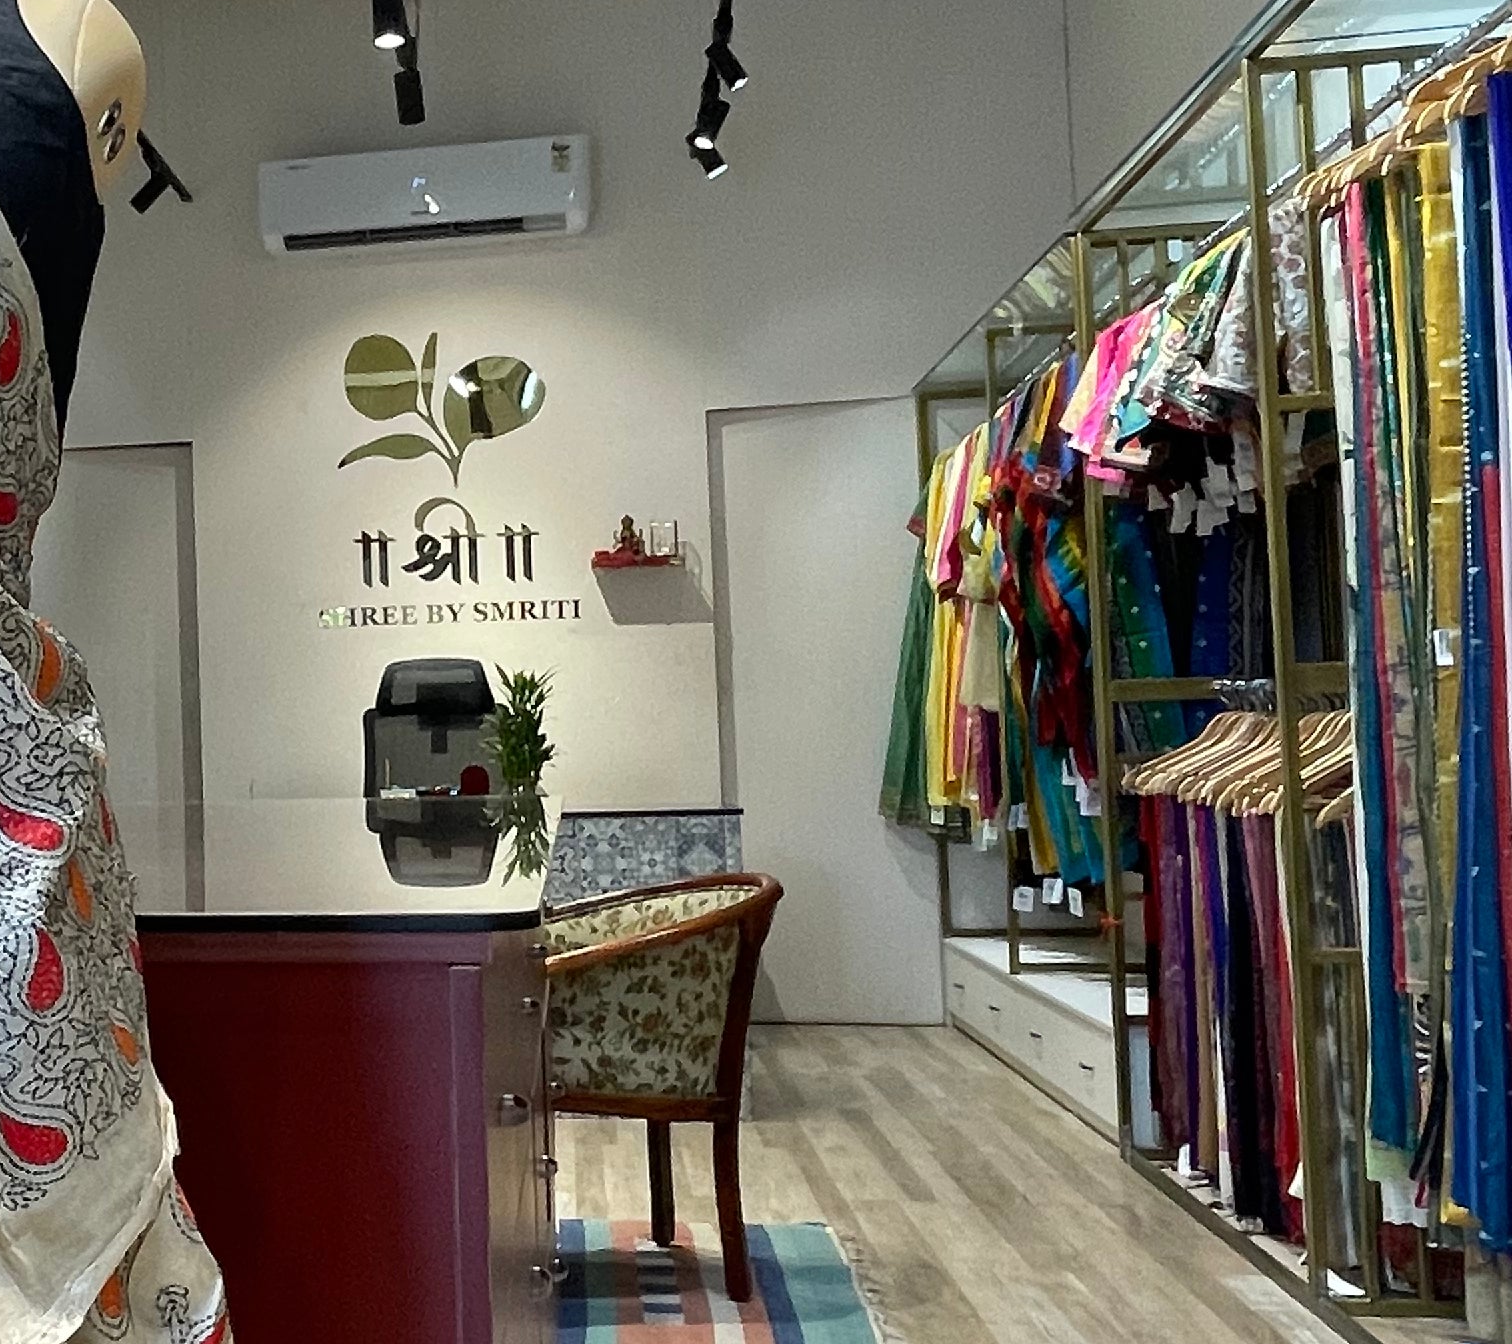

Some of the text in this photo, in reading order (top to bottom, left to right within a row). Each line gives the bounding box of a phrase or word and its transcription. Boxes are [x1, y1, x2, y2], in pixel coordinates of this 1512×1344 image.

[318, 598, 582, 629] SHREE BY SMRITI
